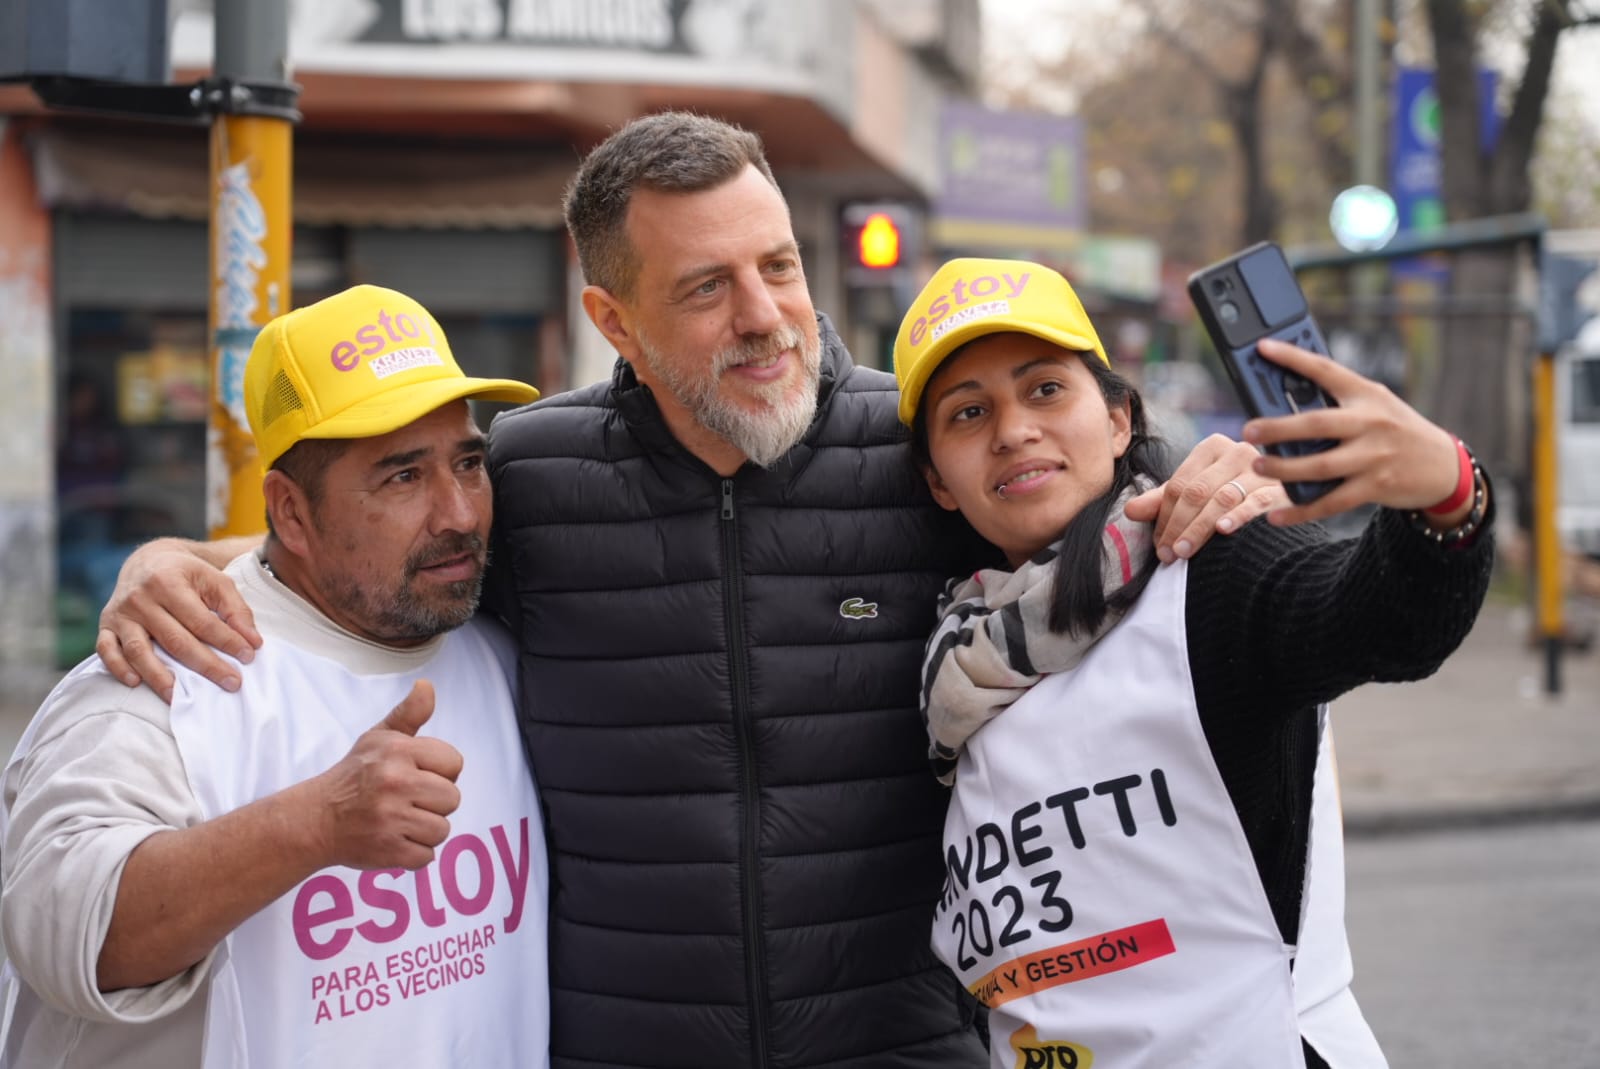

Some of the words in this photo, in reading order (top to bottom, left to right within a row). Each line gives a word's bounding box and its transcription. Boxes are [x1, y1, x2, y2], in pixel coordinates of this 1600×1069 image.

[330, 308, 436, 372] estoy
[910, 272, 1031, 347] estoy
[934, 768, 1177, 916] NDETTI
[292, 816, 530, 961] estoy
[952, 870, 1073, 972] 2023
[312, 961, 380, 1000] PARA
[386, 924, 496, 979] ESCUCHAR
[314, 1000, 333, 1025] A
[340, 983, 391, 1018] LOS
[396, 953, 486, 1000] VECINOS
[1003, 968, 1019, 988] Y
[1026, 935, 1139, 983] GESTIÓN
